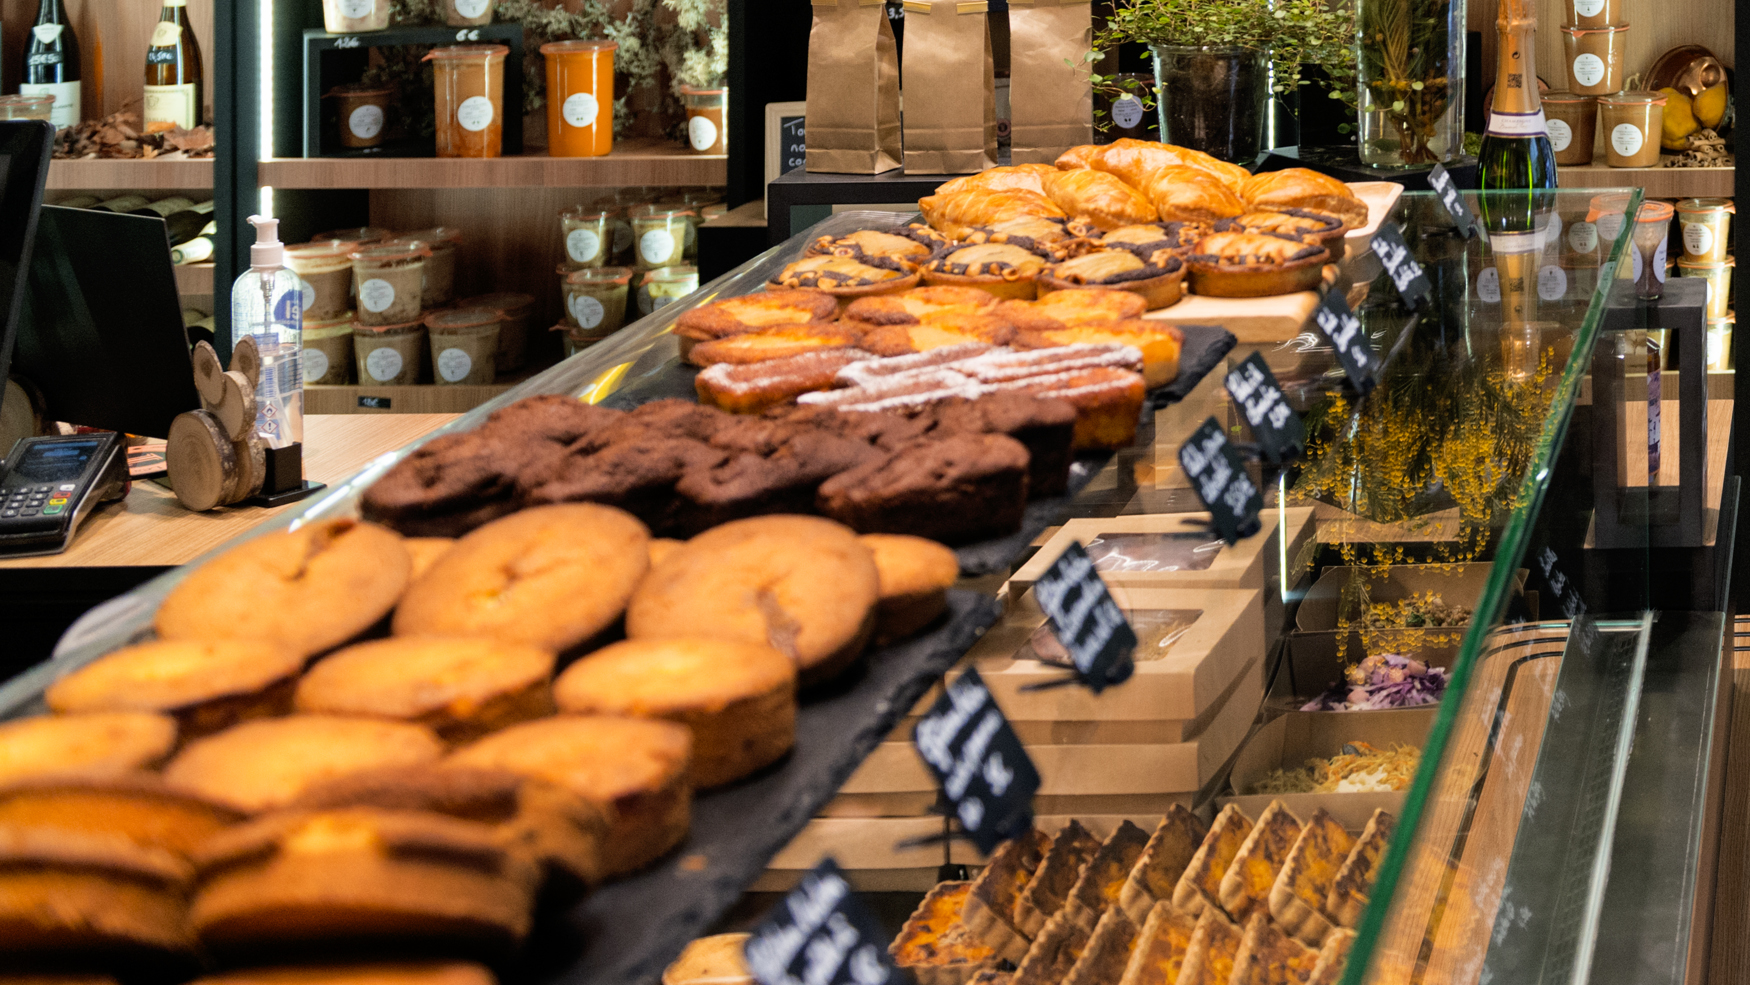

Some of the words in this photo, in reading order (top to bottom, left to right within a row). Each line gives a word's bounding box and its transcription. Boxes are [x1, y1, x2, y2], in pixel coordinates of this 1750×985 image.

[889, 7, 905, 19] 3,5
[783, 117, 806, 137] To
[788, 156, 806, 167] co
